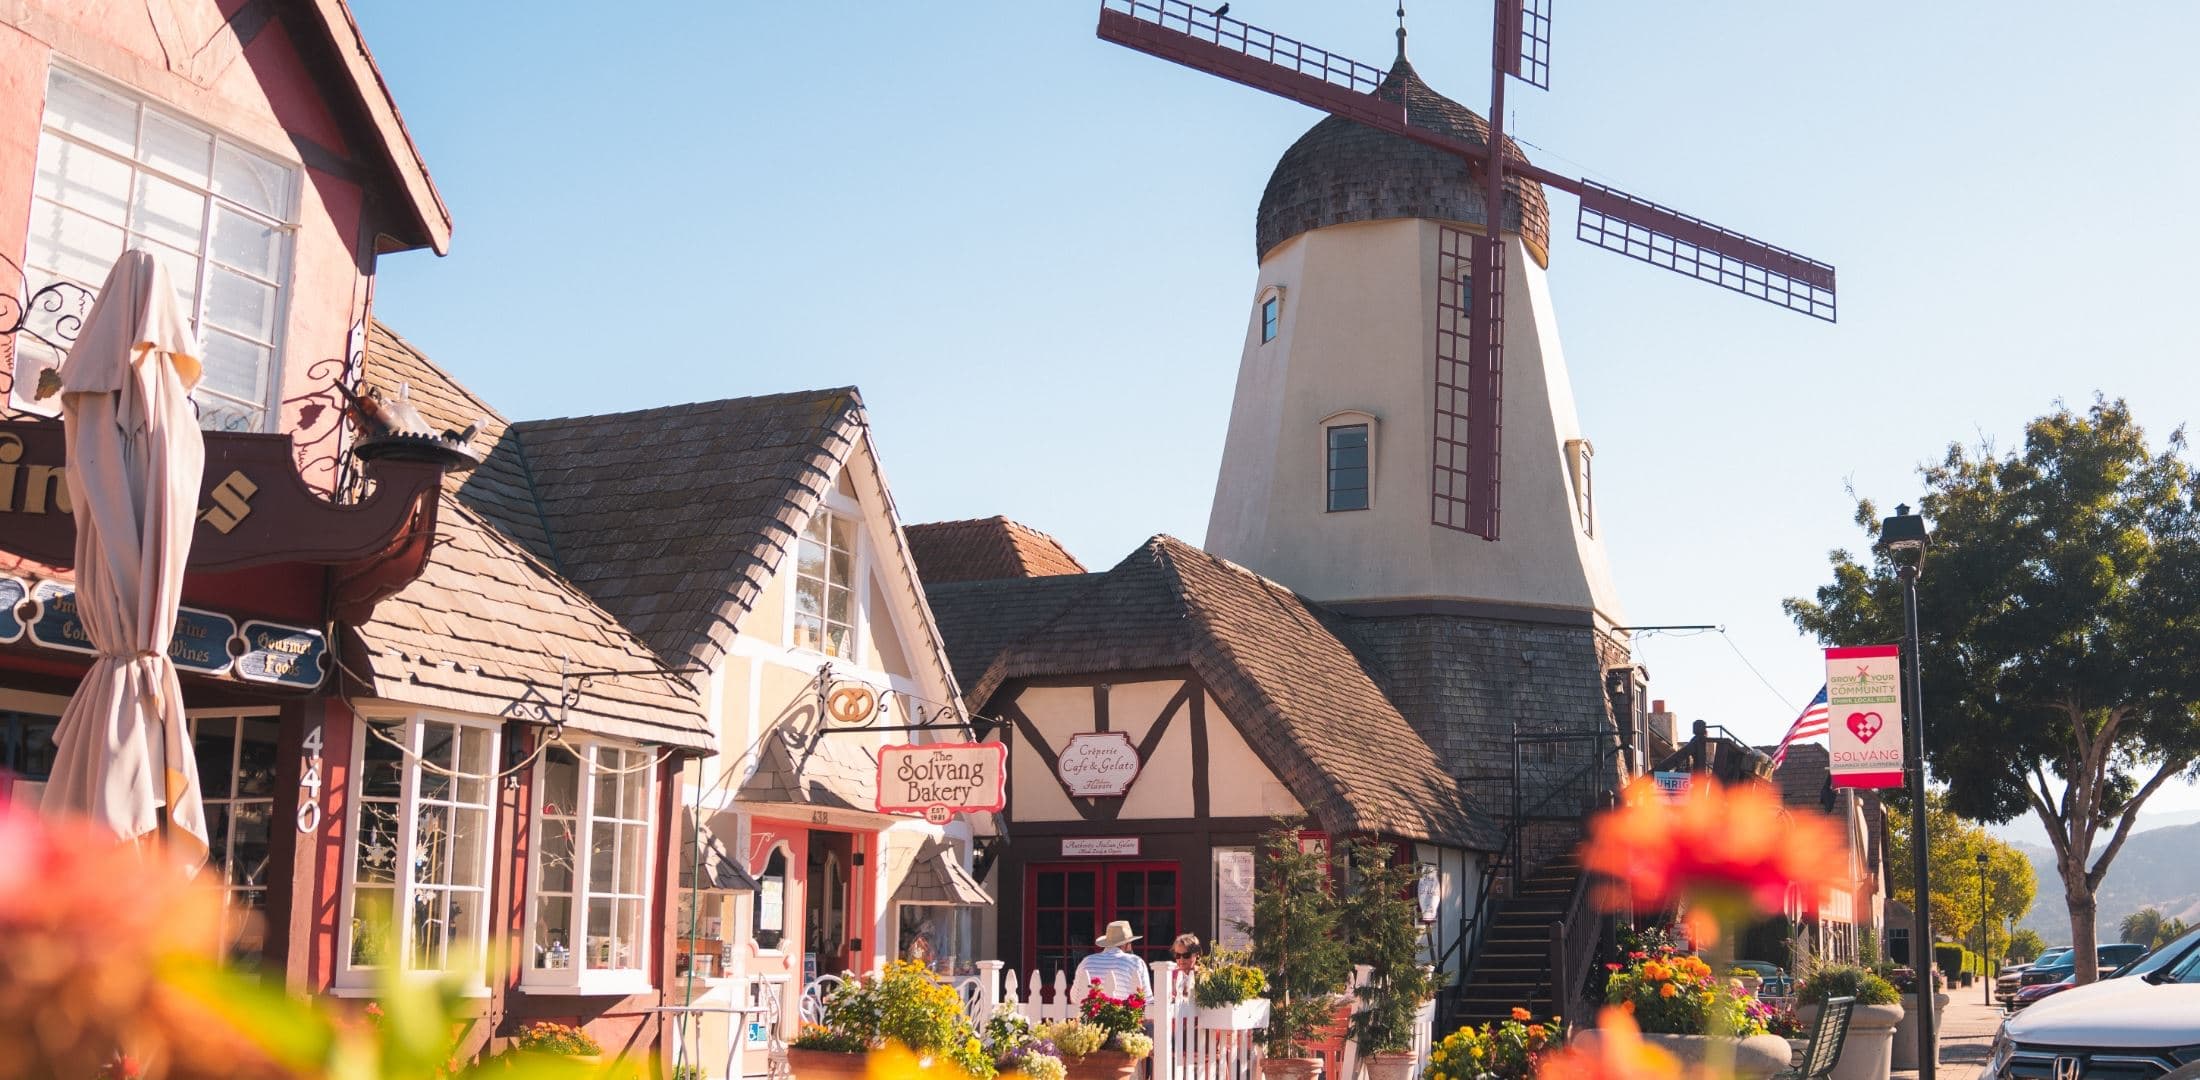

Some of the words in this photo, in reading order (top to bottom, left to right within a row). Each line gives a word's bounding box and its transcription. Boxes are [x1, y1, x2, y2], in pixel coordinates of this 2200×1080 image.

[257, 632, 312, 655] Gourmet
[1871, 674, 1895, 682] YOUR
[1831, 686, 1896, 695] COMMUNITY
[933, 751, 953, 762] The
[1833, 750, 1899, 762] SOLVANG
[897, 754, 984, 787] Solvang
[1063, 758, 1089, 775] Cafe
[1090, 761, 1098, 770] &
[1098, 756, 1134, 773] Gelato
[297, 725, 324, 833] 440
[1656, 779, 1689, 789] UHRIG
[907, 781, 973, 806] Bakery
[812, 810, 829, 824] 438
